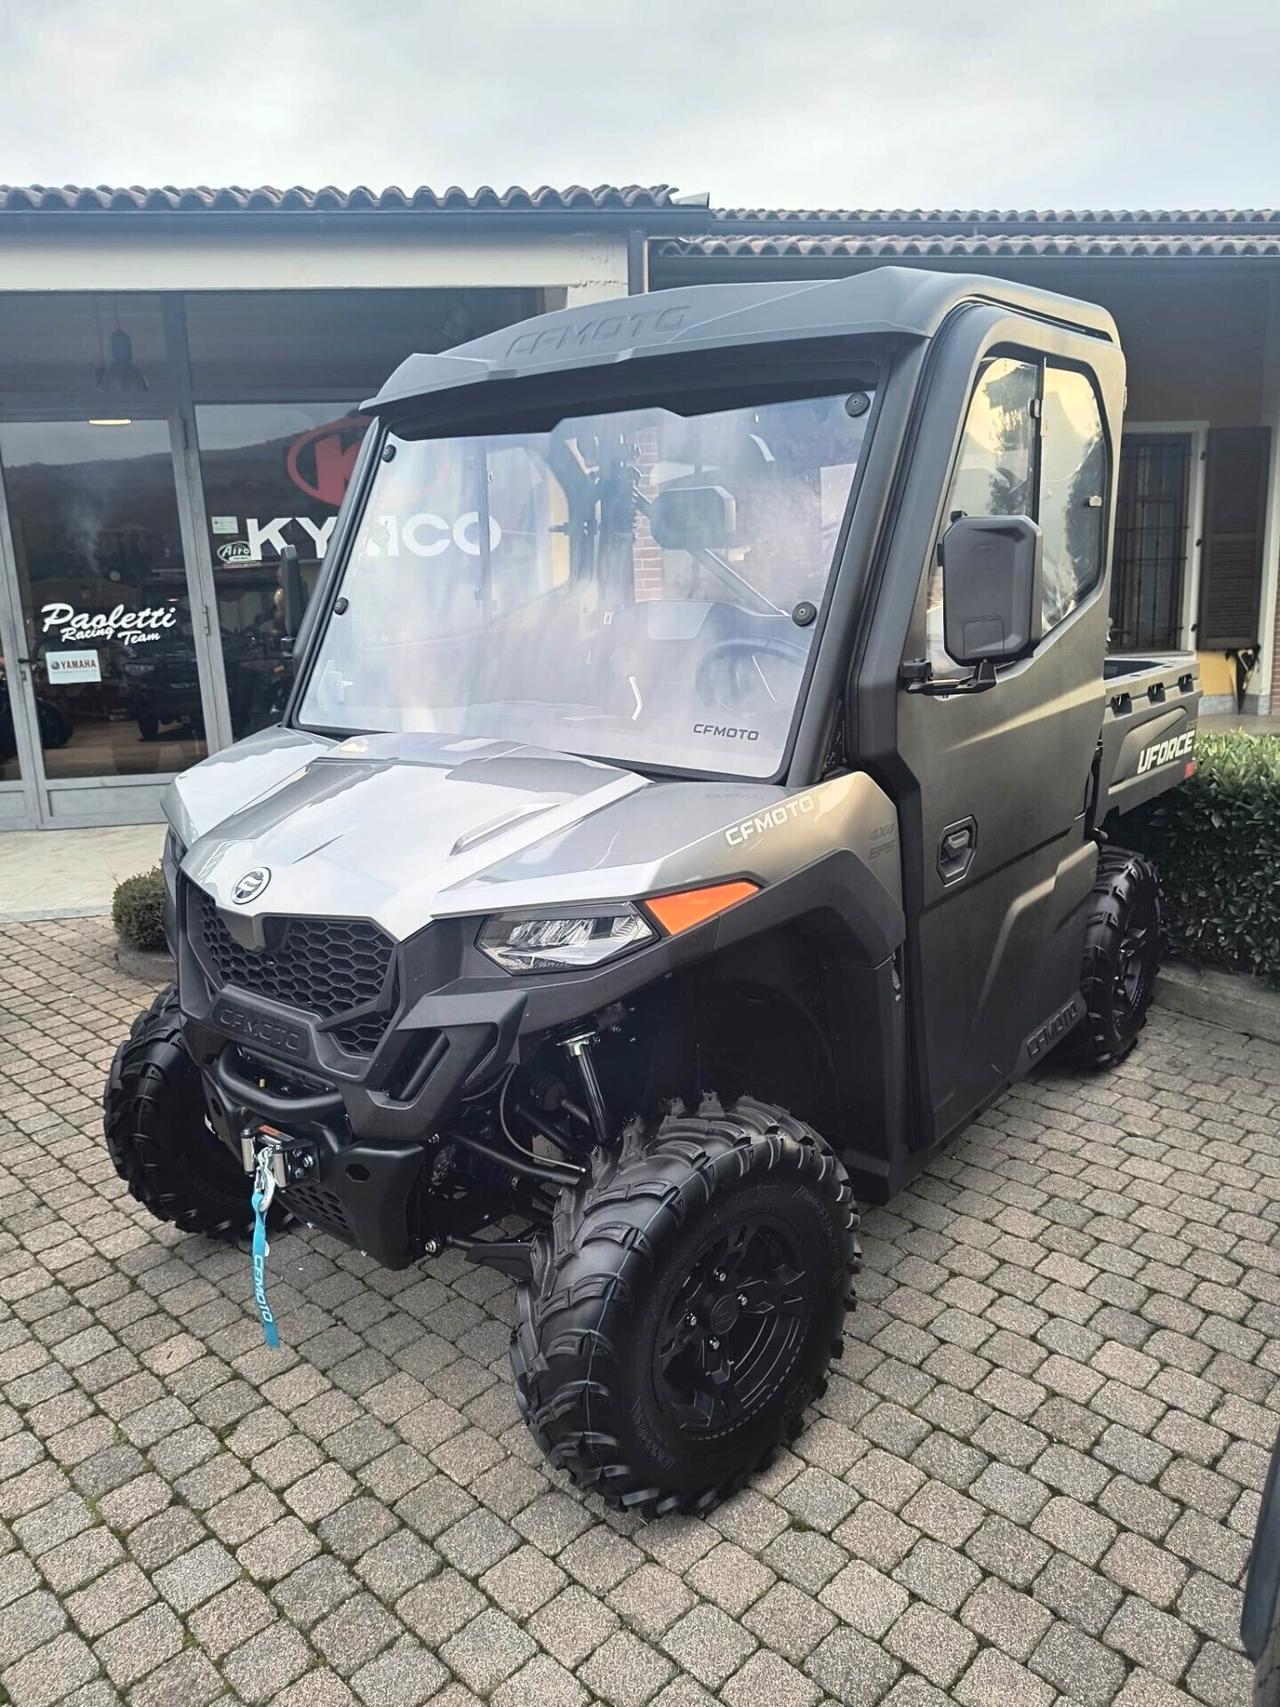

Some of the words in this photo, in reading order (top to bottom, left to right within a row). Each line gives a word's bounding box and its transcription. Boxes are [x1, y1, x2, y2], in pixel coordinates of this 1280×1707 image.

[506, 305, 692, 358] CFMOTO
[41, 602, 177, 633] Paoletti
[60, 626, 116, 642] Racing
[117, 630, 161, 646] Team
[61, 659, 97, 670] YAMAHA
[693, 723, 759, 741] CFMOTO
[1137, 730, 1195, 774] UFORCE
[724, 795, 816, 846] CFMOTO
[220, 1008, 301, 1051] CFMOTO
[253, 1254, 273, 1323] CFMOTO
